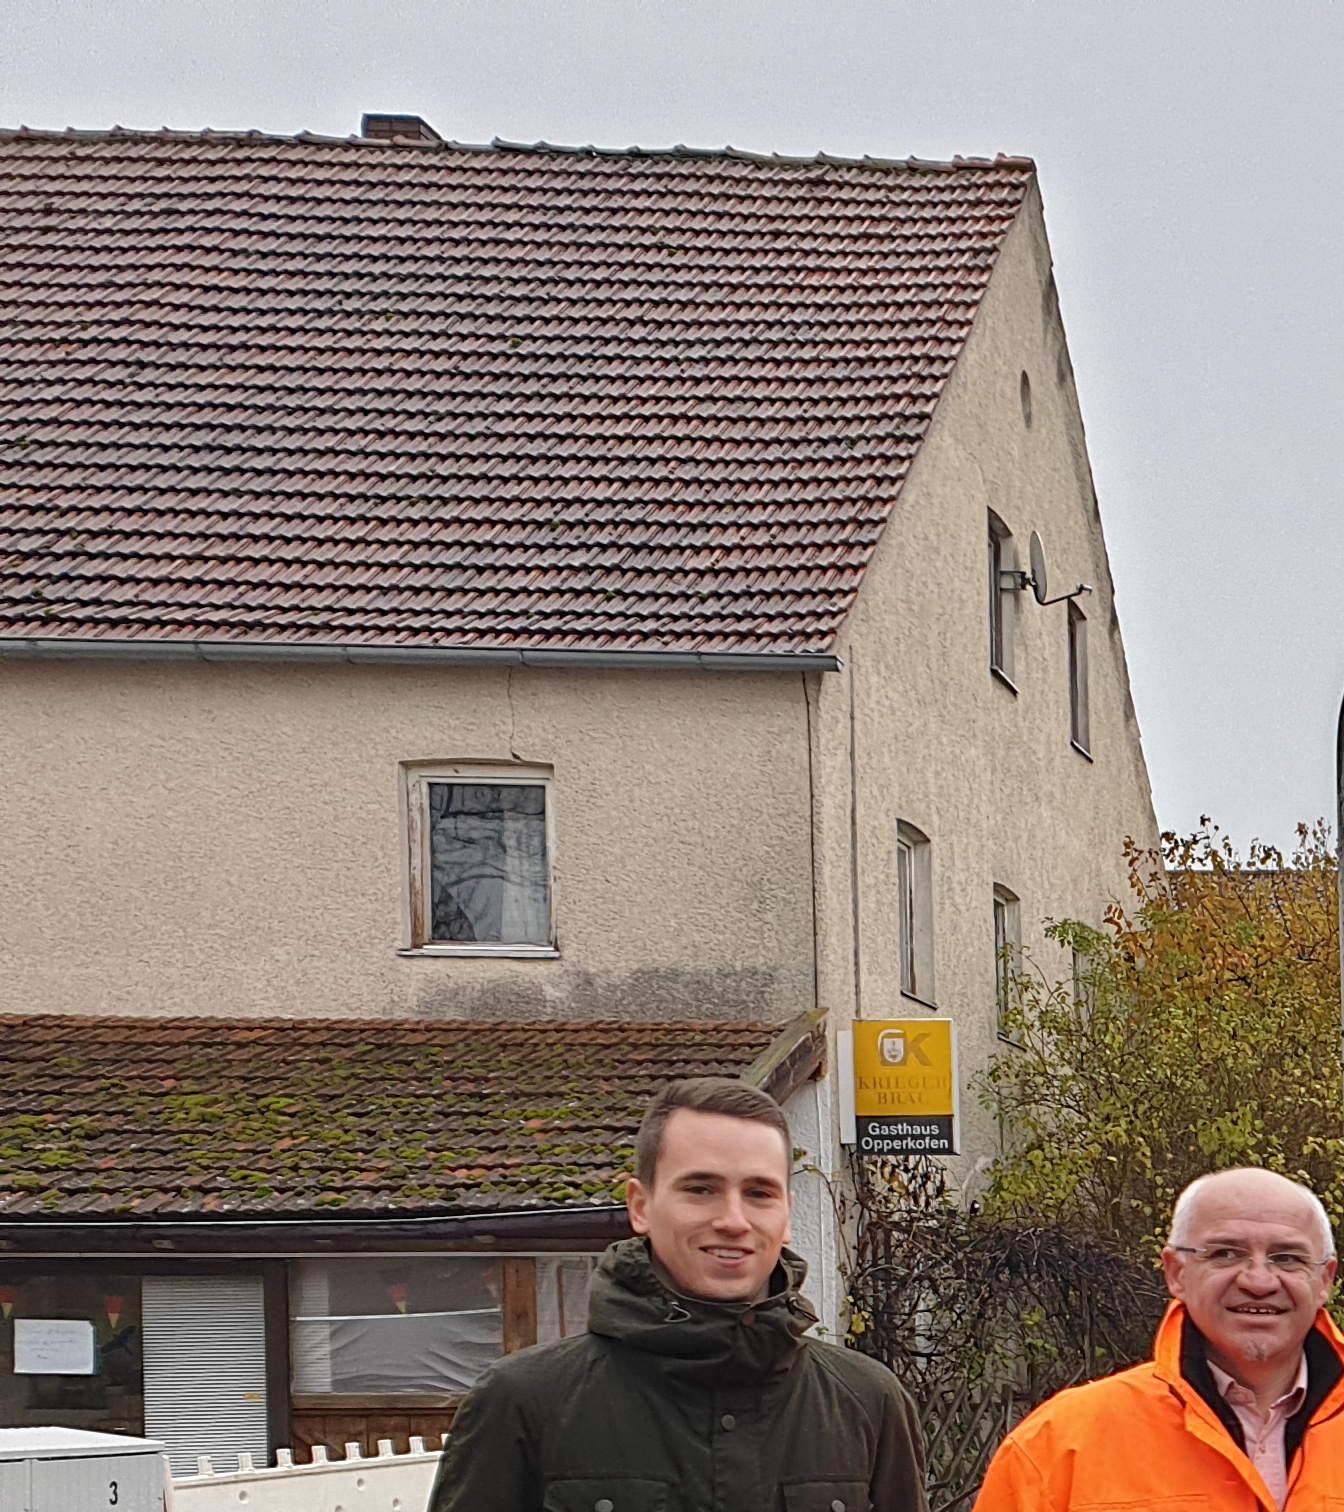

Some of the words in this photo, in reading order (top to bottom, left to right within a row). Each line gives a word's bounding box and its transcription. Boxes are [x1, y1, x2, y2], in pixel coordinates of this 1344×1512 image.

[868, 1122, 940, 1136] Gasthaus
[861, 1136, 949, 1152] Opperkofen
[109, 1481, 118, 1506] 3
